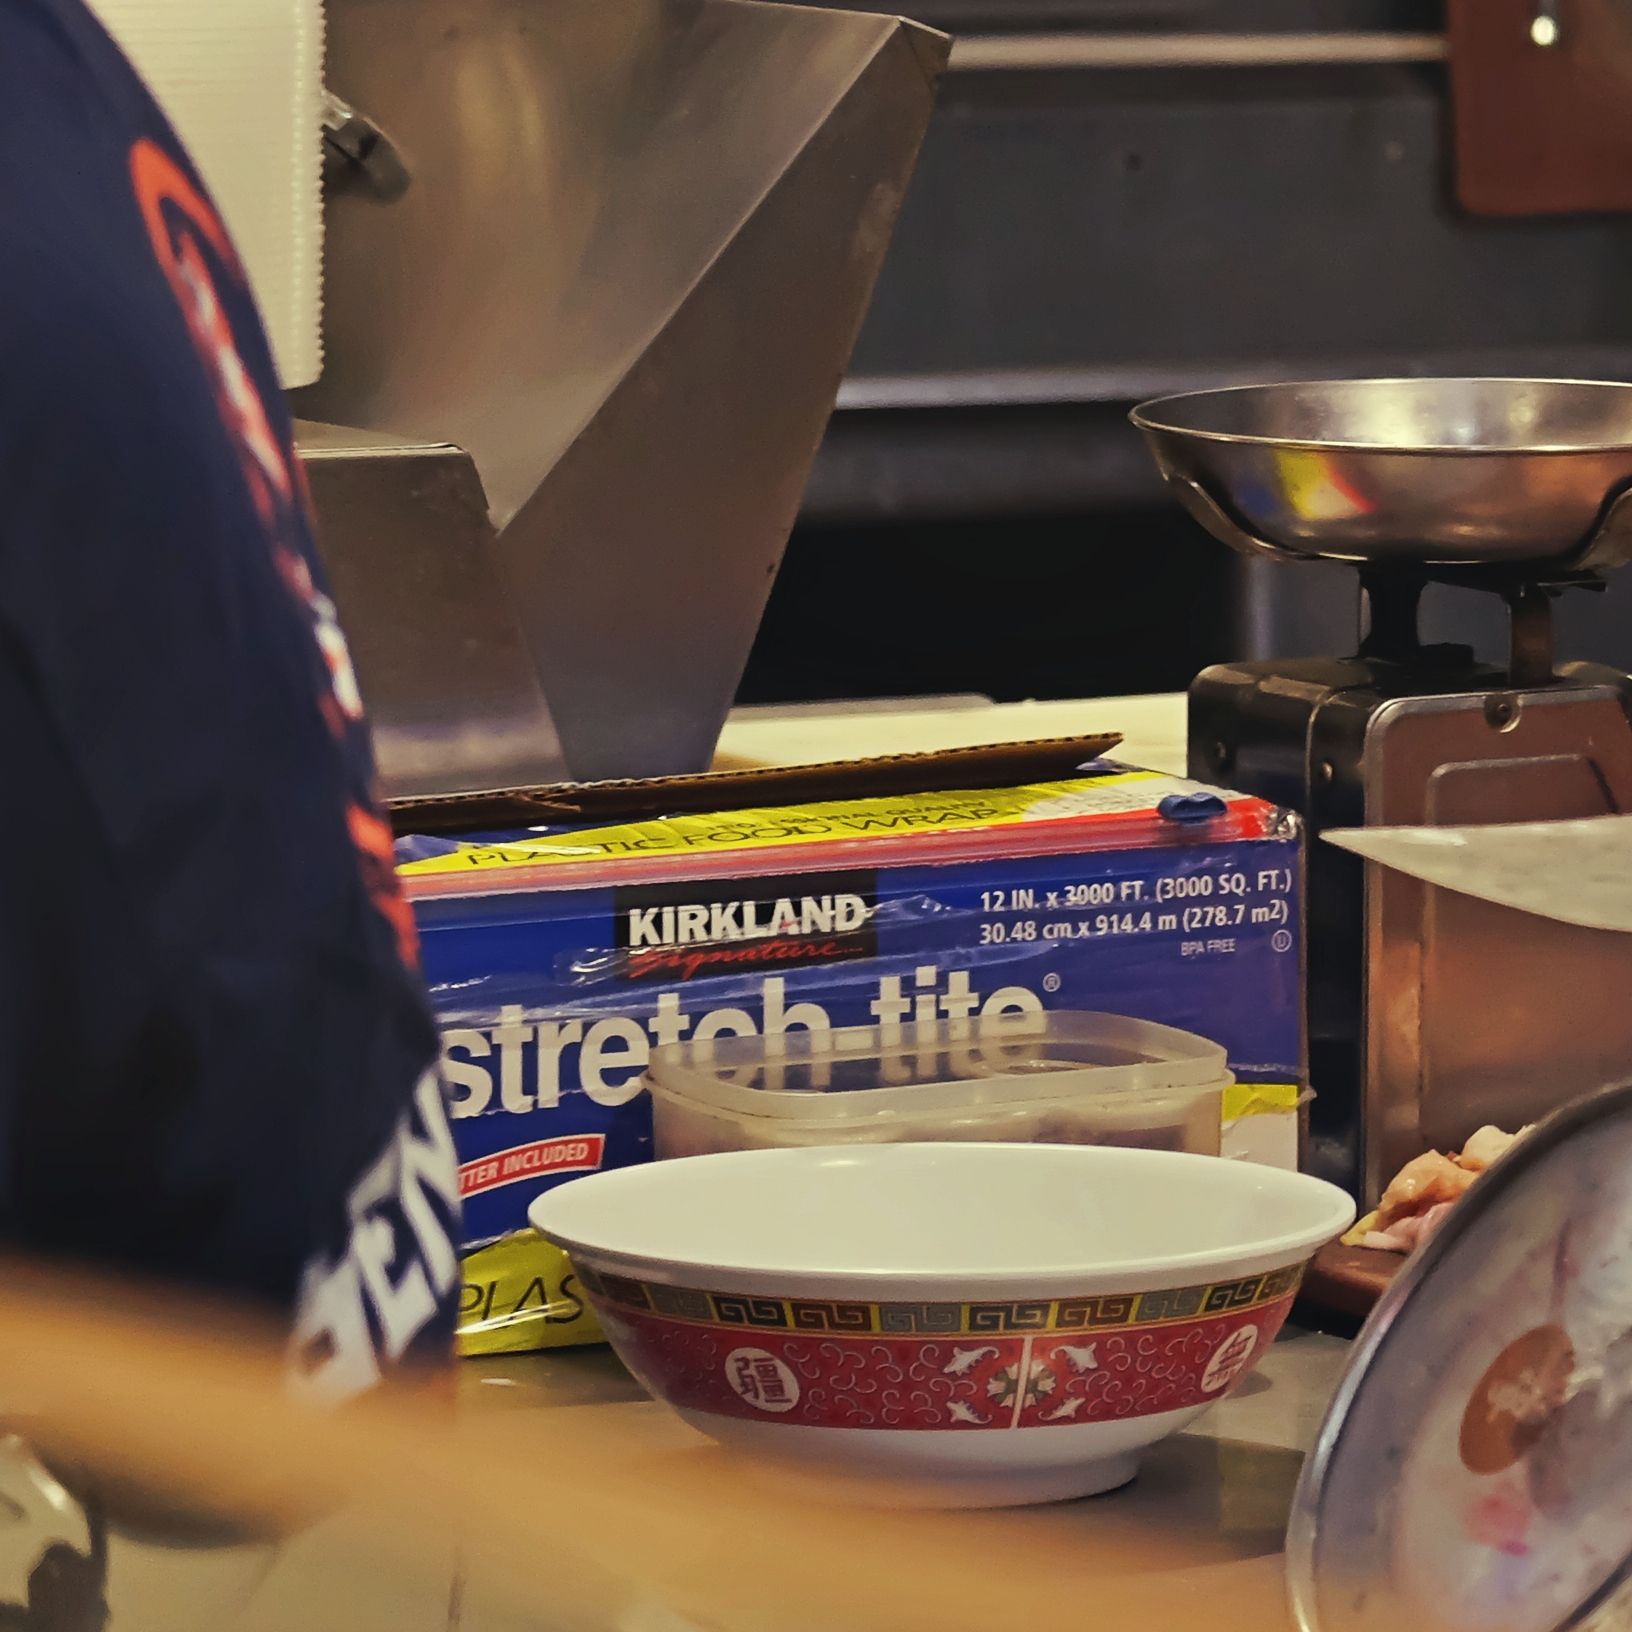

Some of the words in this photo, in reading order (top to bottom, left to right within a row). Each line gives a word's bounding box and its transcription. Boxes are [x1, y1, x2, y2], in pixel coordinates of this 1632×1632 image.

[682, 822, 832, 846] FOOD
[840, 808, 999, 830] WRAP
[980, 890, 1004, 912] 12
[1011, 888, 1039, 910] IN.
[1046, 892, 1059, 908] x
[1064, 882, 1114, 906] 3000
[1121, 879, 1149, 901] FT.
[1156, 874, 1213, 902] (3000
[1218, 872, 1251, 894] SQ.
[1257, 868, 1292, 893] FT.)
[629, 894, 867, 946] KIRKLAND
[979, 921, 1036, 945] 30.48
[1042, 923, 1072, 940] cm
[1077, 922, 1090, 939] x
[1095, 911, 1151, 935] 914.4
[1157, 913, 1177, 931] m
[1183, 905, 1246, 933] (278.7
[1180, 940, 1205, 956] BPA
[1207, 938, 1236, 953] FREE
[440, 965, 1048, 1119] stretch-tite
[502, 1142, 588, 1176] INCLUDED
